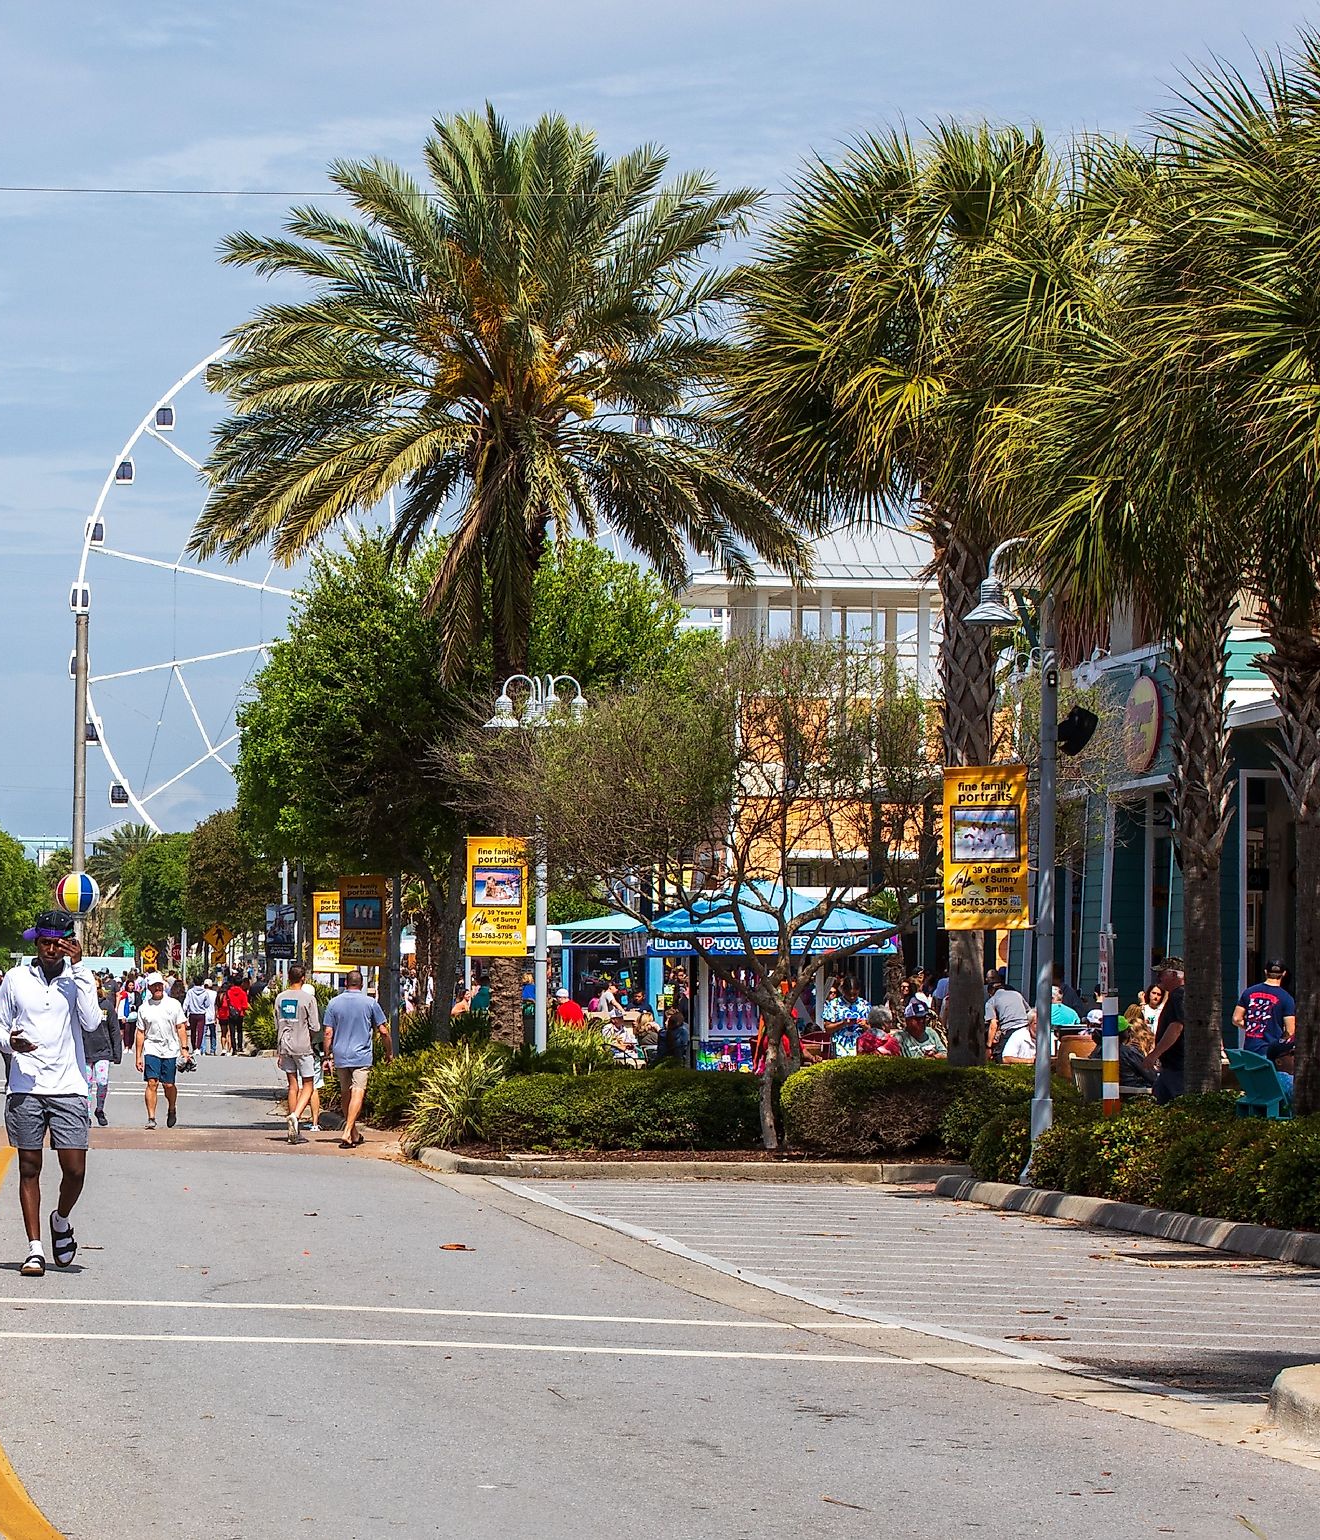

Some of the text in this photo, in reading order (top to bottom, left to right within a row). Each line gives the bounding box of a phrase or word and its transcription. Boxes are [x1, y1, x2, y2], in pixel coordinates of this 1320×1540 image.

[958, 781, 1012, 793] fine family
[958, 792, 1013, 804] portraits
[973, 866, 983, 874] 39
[1011, 865, 1020, 873] of
[990, 875, 1018, 885] Sunny
[985, 885, 1014, 893] Smiles
[951, 898, 1008, 906] 850-763-5795
[751, 936, 810, 949] BUBES
[811, 935, 840, 949] AND
